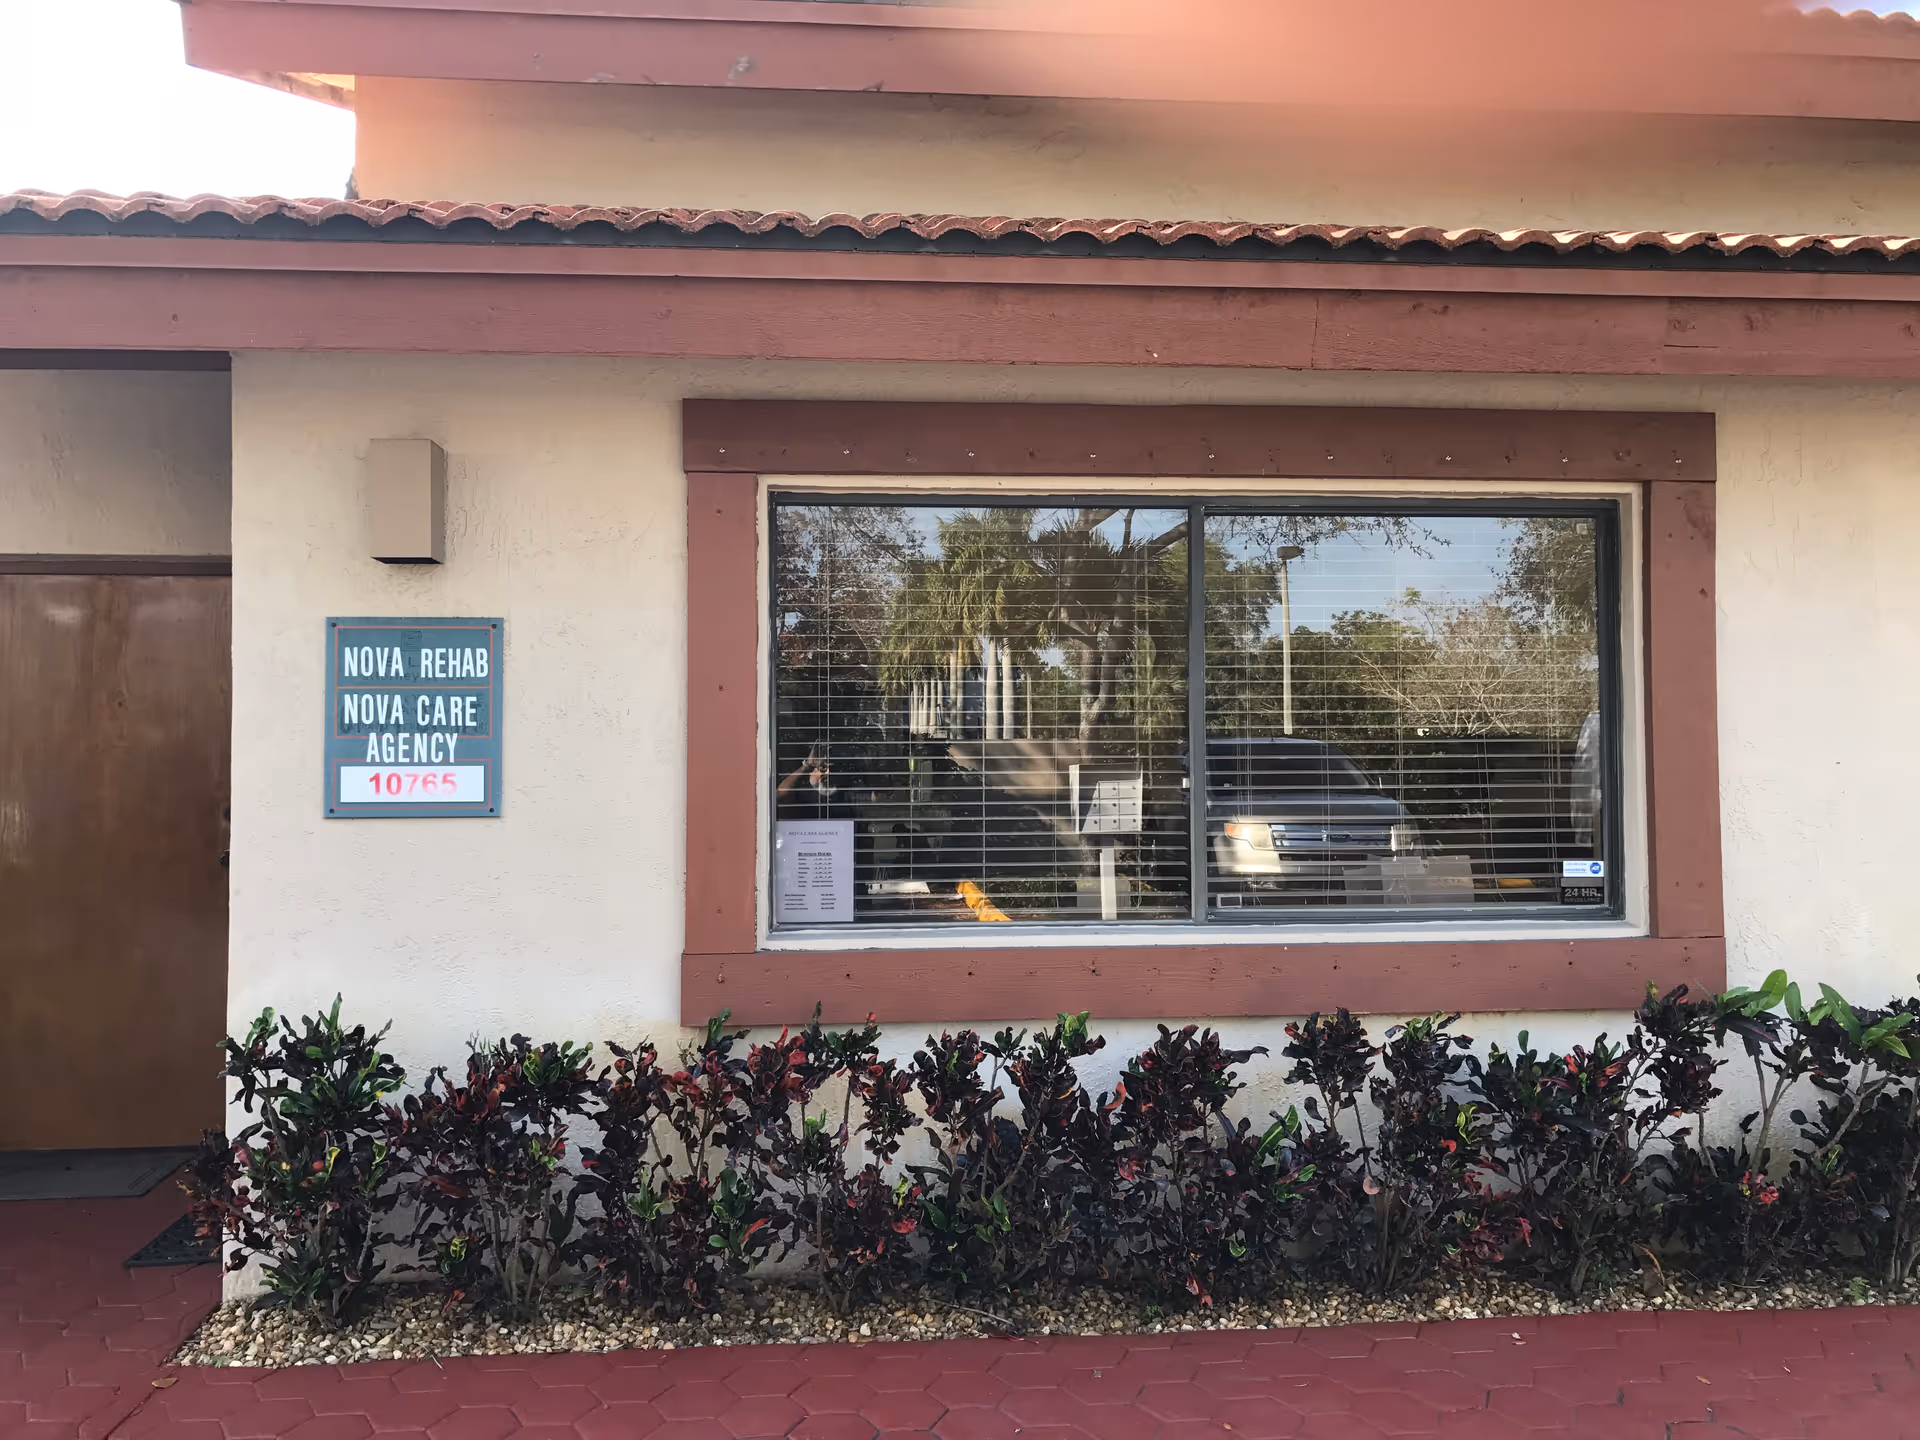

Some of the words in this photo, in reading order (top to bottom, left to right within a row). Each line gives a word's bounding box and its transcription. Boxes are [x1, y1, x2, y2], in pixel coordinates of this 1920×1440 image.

[344, 646, 404, 677] NOVA
[420, 648, 489, 678] REHAB
[343, 693, 404, 725] NOVA
[417, 695, 478, 727] CARE
[366, 732, 458, 763] AGENCY
[369, 772, 457, 796] 10765
[1564, 888, 1578, 897] 24
